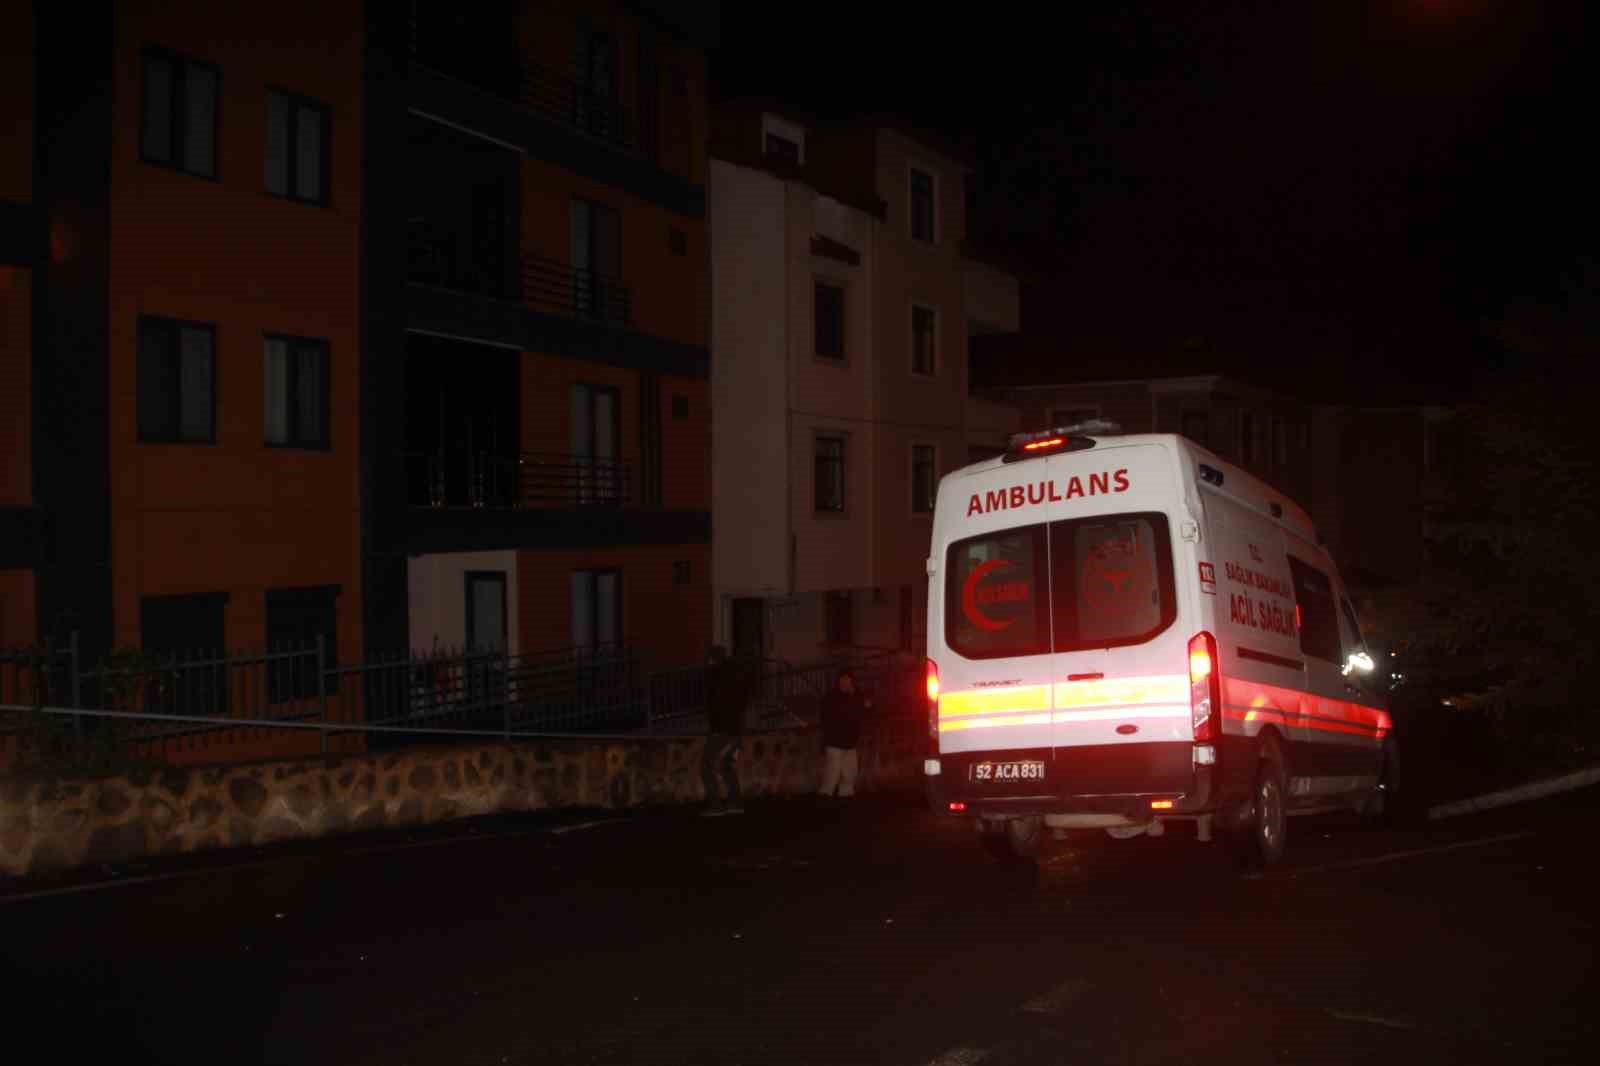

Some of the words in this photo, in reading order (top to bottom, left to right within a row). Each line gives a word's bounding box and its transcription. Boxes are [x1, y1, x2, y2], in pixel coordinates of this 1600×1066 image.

[967, 468, 1130, 517] AMBULANS
[1231, 590, 1257, 628] ACİL
[975, 765, 992, 779] 52
[995, 764, 1020, 778] ACA
[1021, 763, 1042, 778] 831
